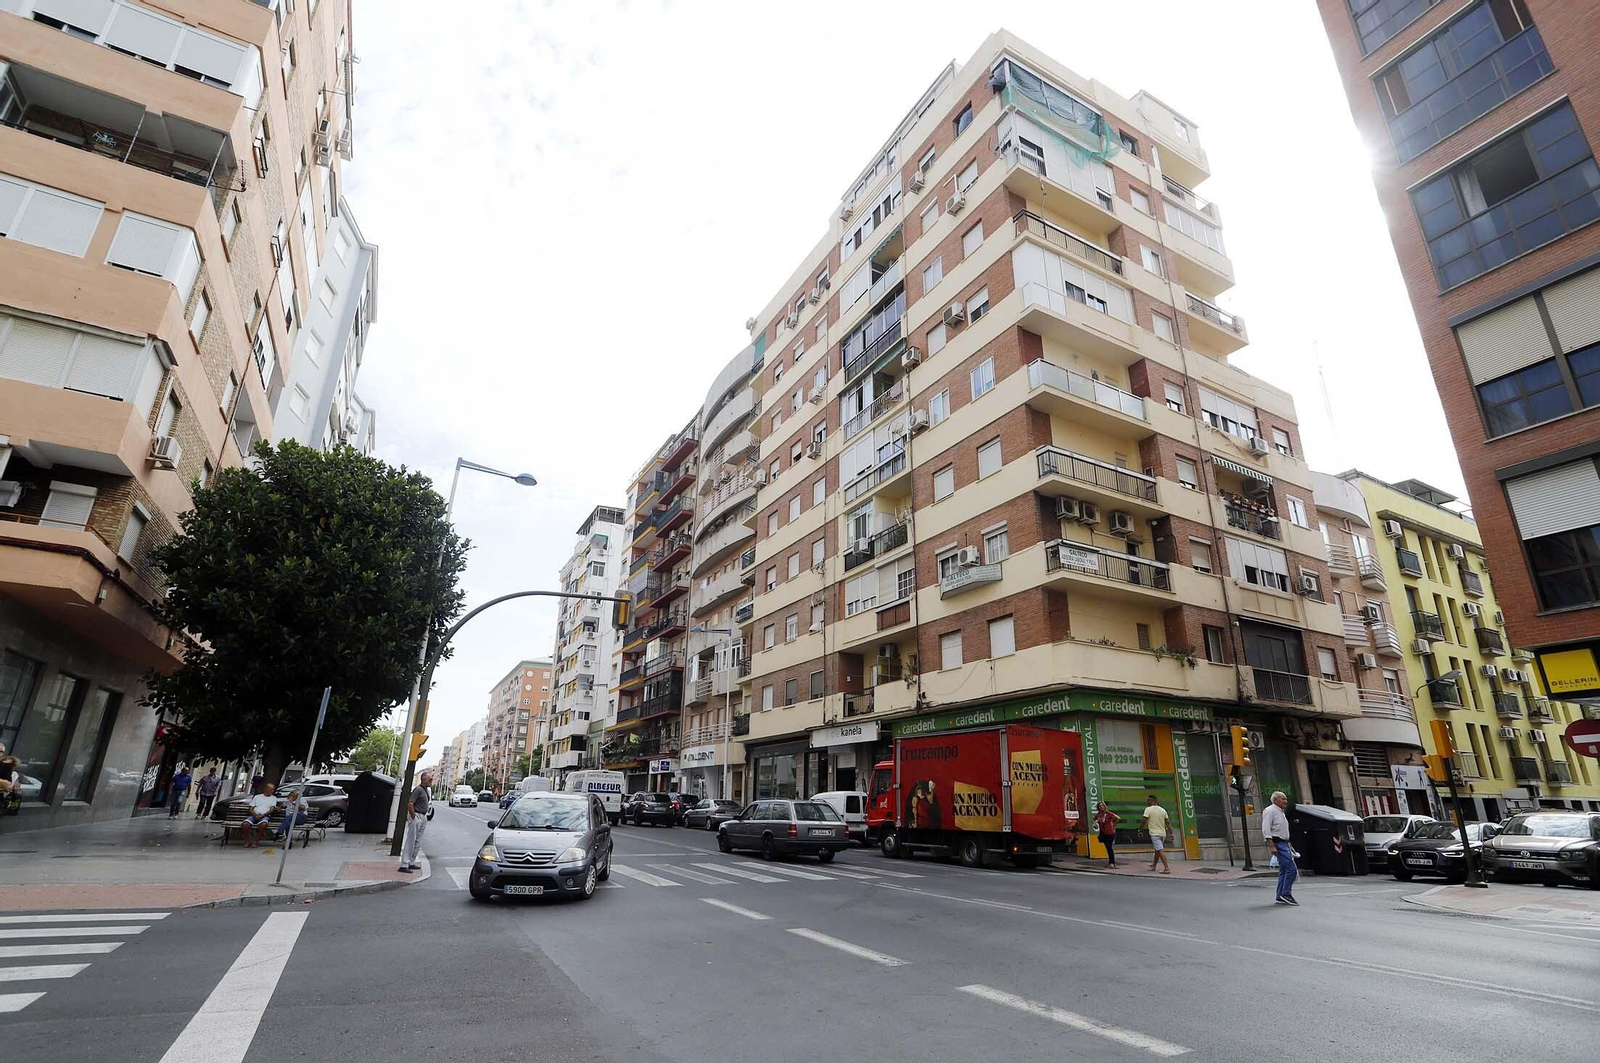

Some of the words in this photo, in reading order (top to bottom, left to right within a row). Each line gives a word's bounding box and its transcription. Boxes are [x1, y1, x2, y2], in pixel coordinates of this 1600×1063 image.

[1022, 695, 1071, 717] caredent
[1100, 699, 1146, 715] caredent
[1169, 705, 1209, 721] caredent
[955, 708, 995, 727] caredent
[841, 726, 862, 737] kanela
[902, 718, 936, 735] caredent
[1085, 723, 1096, 774] DENTAL
[1114, 754, 1128, 764] 229
[1129, 755, 1142, 765] 947
[1013, 771, 1048, 782] ACENTO
[1174, 738, 1193, 819] caredent
[588, 782, 621, 791] ALBESUR
[967, 793, 997, 805] MUCHO
[953, 805, 998, 817] ACENTO
[508, 886, 527, 894] 5900
[528, 886, 542, 894] GPR
